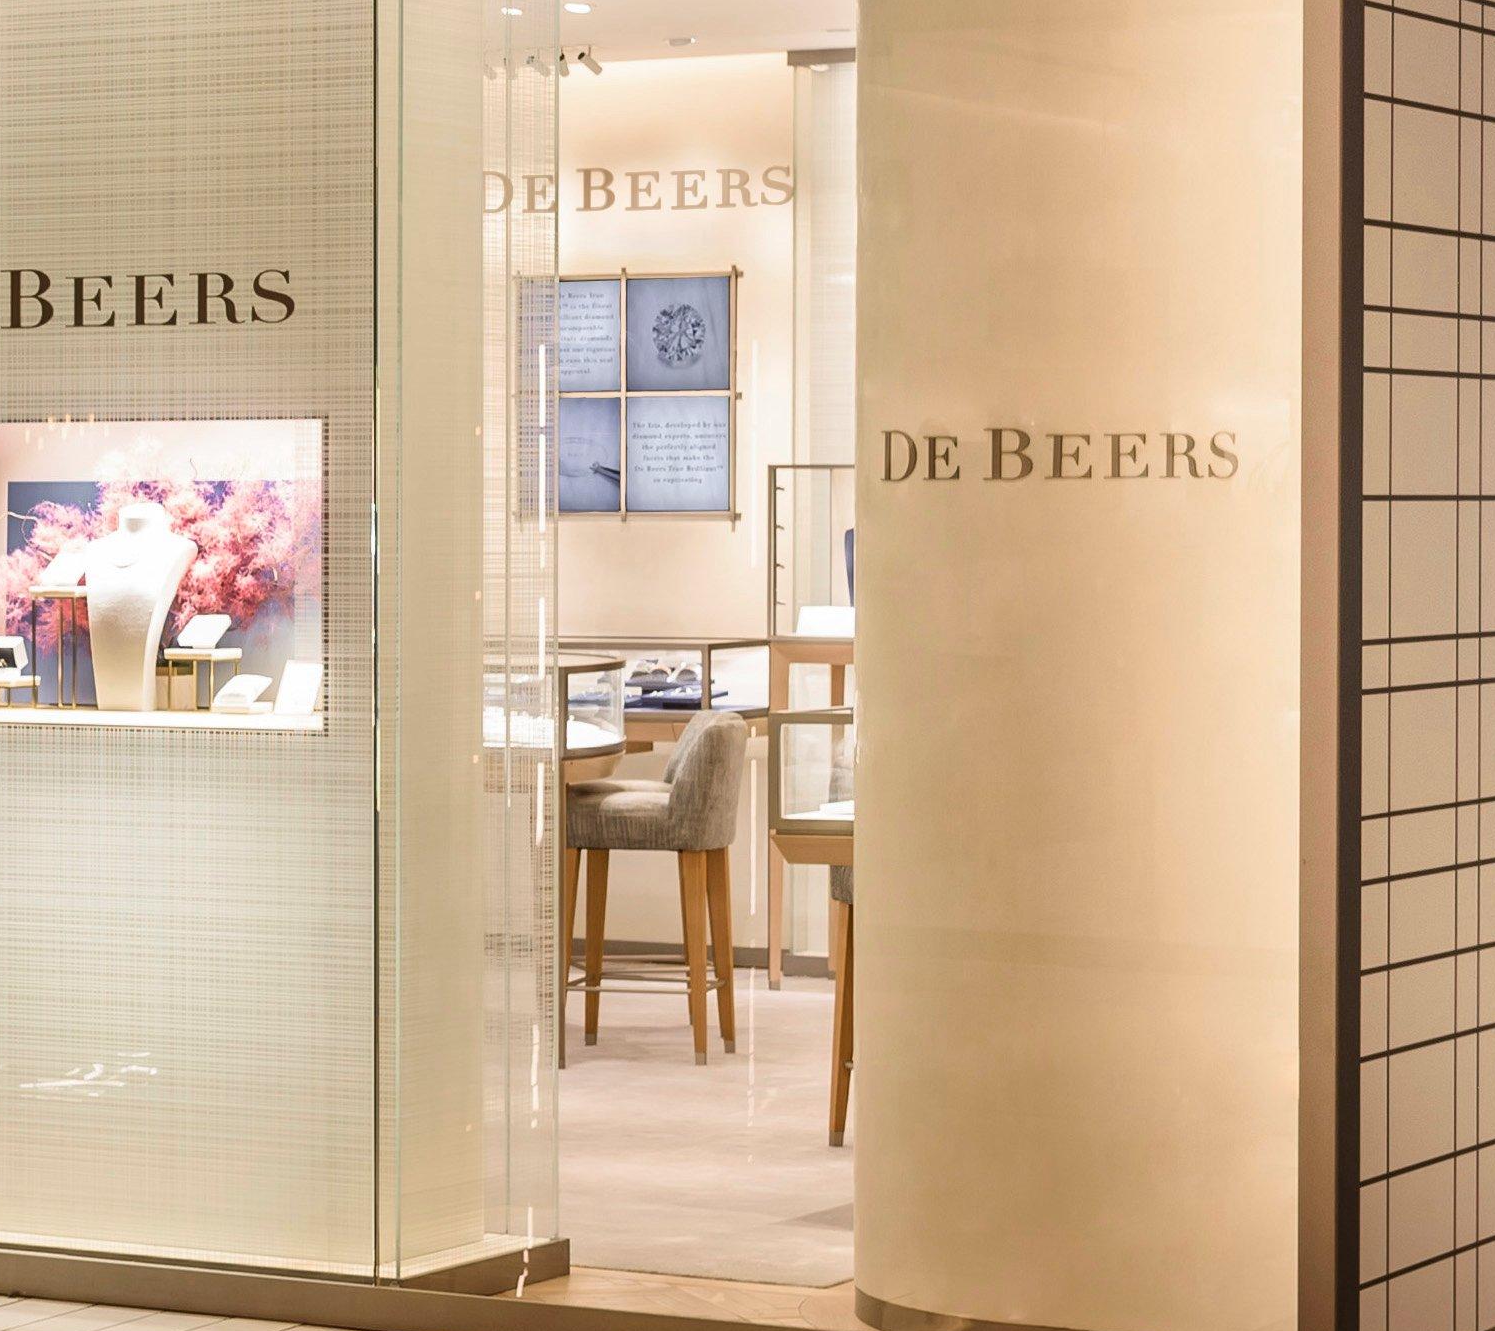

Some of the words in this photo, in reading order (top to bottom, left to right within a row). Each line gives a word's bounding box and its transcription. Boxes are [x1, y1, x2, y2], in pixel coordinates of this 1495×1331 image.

[483, 170, 556, 213] DE
[575, 165, 795, 211] BEERS
[0, 268, 296, 330] BEERS
[880, 430, 961, 481] DE
[982, 427, 1239, 481] BEERS
